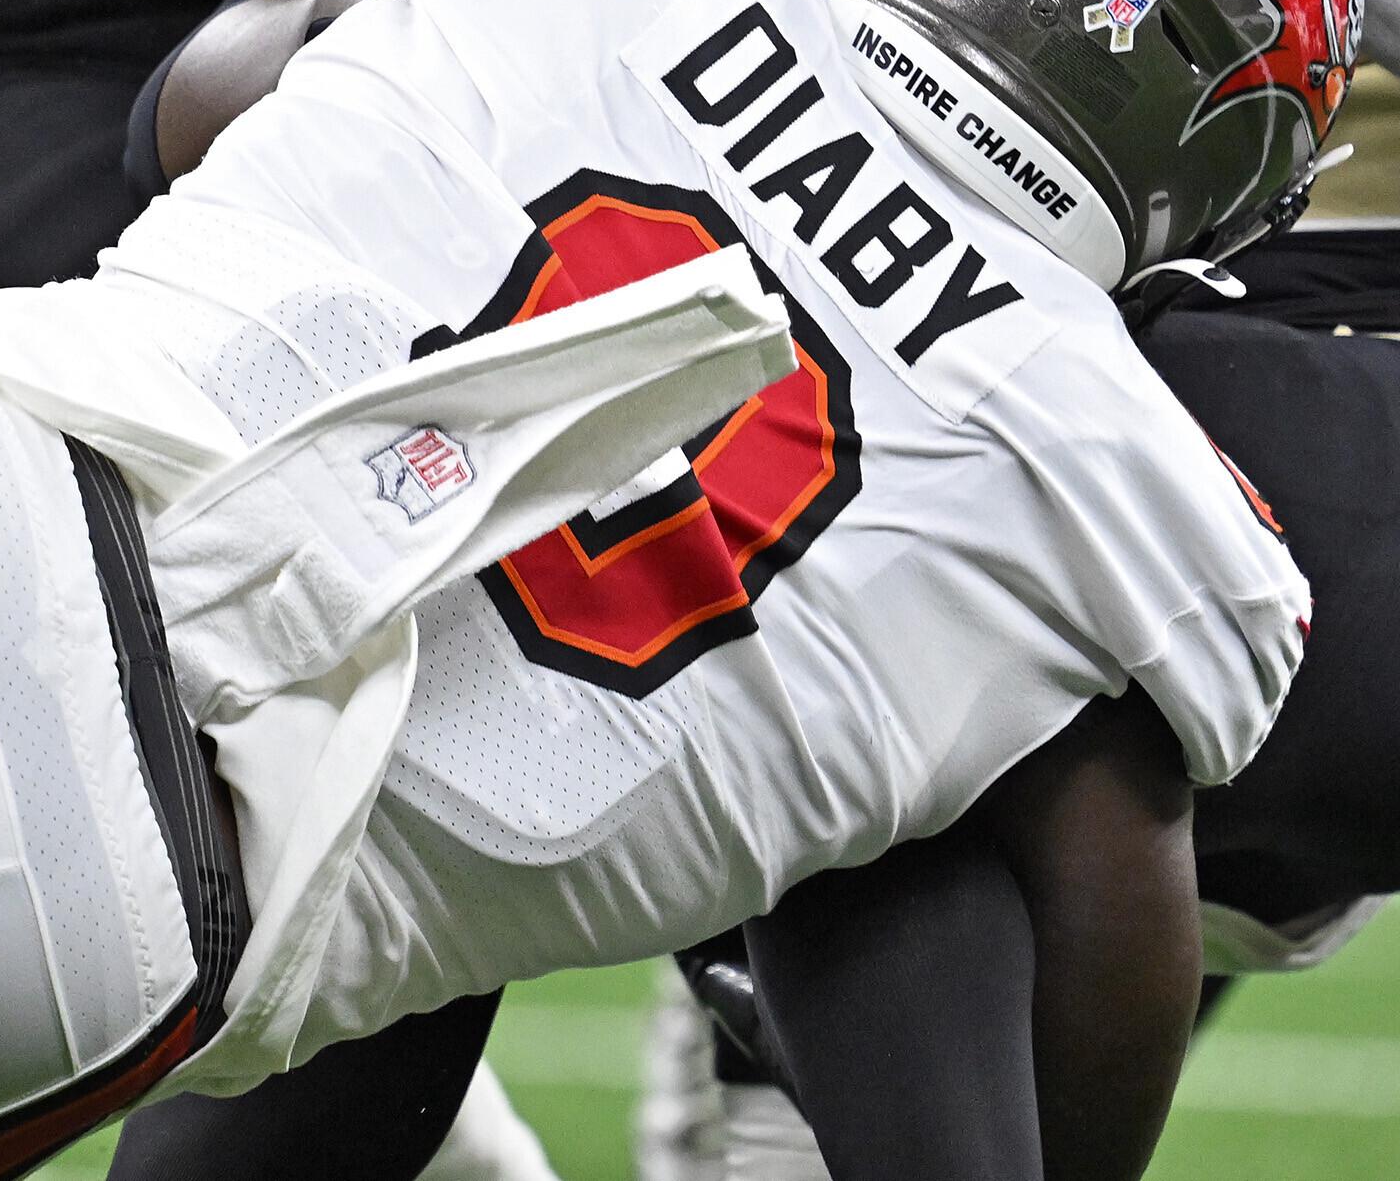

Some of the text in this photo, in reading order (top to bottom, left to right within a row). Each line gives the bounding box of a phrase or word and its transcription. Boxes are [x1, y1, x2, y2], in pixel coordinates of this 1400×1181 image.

[660, 1, 1026, 368] DIABY
[851, 22, 959, 121] INSPIRE
[955, 112, 1078, 220] CHANGE
[399, 427, 469, 492] NFL
